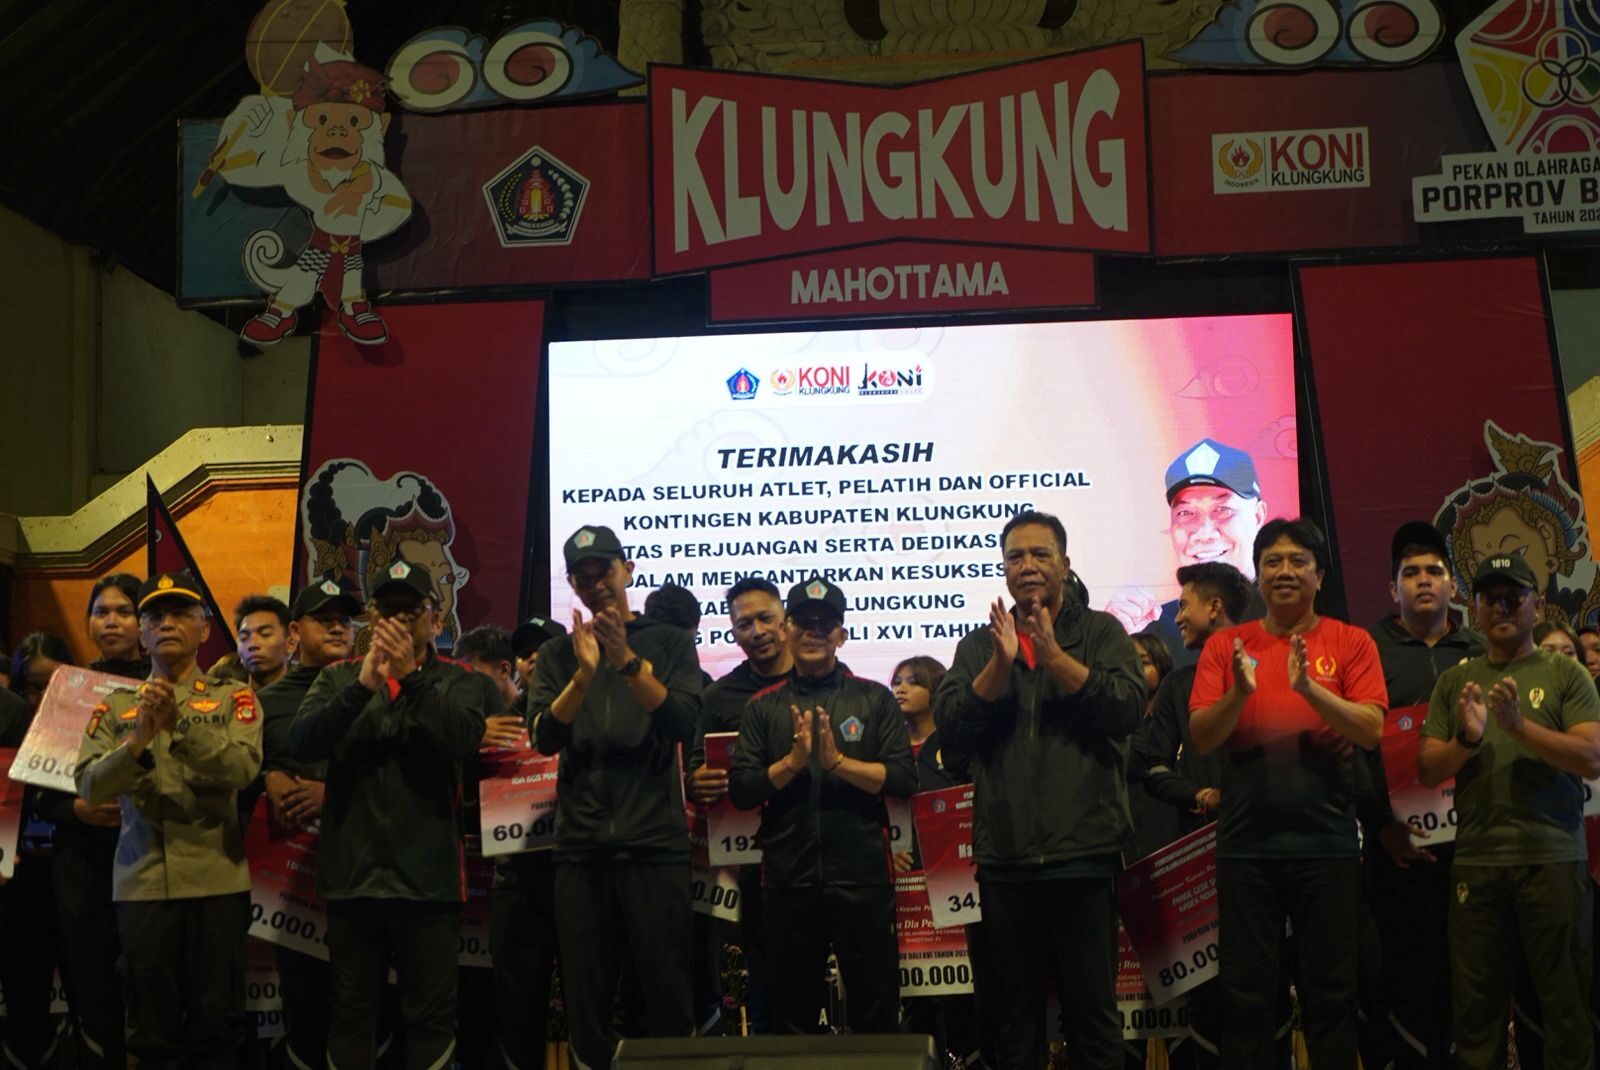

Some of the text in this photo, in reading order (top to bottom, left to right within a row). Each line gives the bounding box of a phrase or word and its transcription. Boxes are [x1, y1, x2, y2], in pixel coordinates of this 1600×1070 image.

[671, 68, 1129, 253] KLUNGKUNG
[1270, 132, 1364, 171] KONI
[1271, 168, 1365, 187] KLUNGKUNG
[1452, 155, 1600, 181] PEKAN OLAHRAGA
[1422, 178, 1566, 213] PORPROV
[1533, 210, 1575, 225] TAHUN
[791, 261, 1009, 304] MAHOTTAMA
[799, 366, 850, 387] KONI
[799, 385, 850, 396] KLUNGKUNG
[717, 442, 934, 469] TERIMAKASIH
[562, 472, 1091, 504] KEPADA SELURUH ATLET, PELATIH DAN OFFICIAL
[623, 503, 1034, 530] KONTINGEN KABUPATEN KLUNGKUNG
[623, 544, 663, 560] TAS
[670, 539, 818, 558] PERJUANGAN
[825, 537, 894, 553] SERTA
[877, 624, 912, 640] XVI
[921, 623, 987, 639] TAHU
